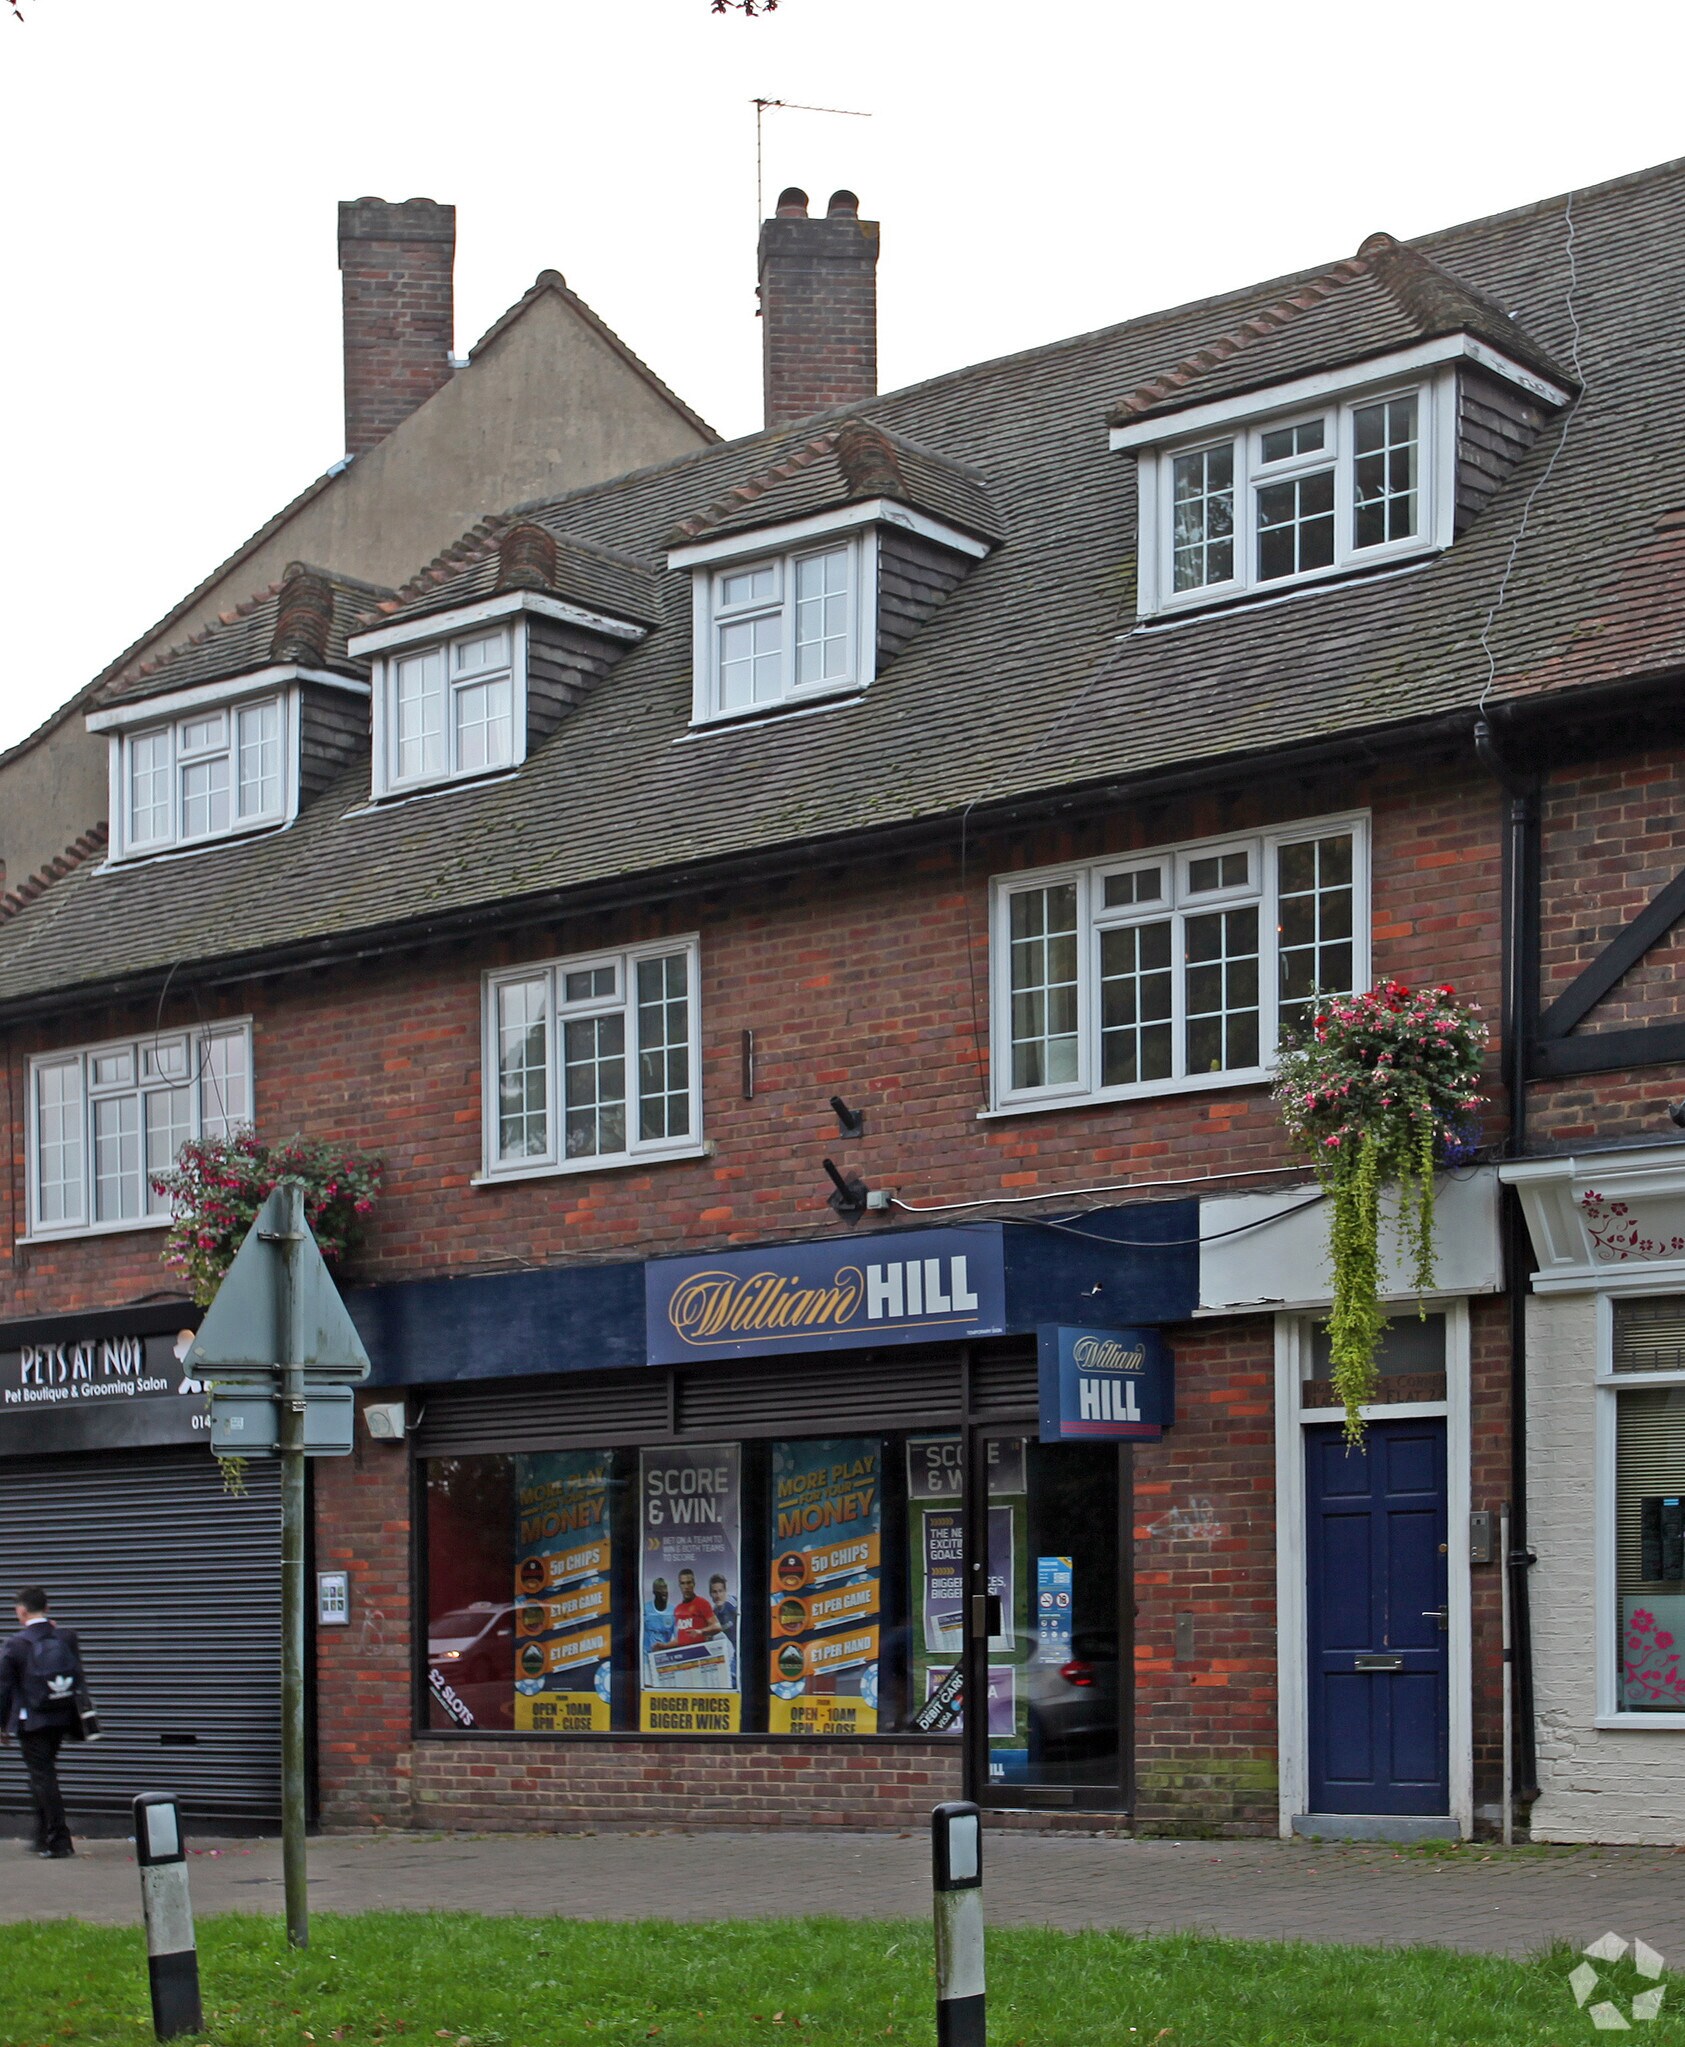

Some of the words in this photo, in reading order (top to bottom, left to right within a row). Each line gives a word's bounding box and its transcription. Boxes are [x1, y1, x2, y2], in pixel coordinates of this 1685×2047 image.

[669, 1266, 864, 1338] William
[866, 1255, 978, 1320] HILL
[21, 1342, 67, 1385] PETS
[72, 1340, 96, 1381] AT
[1073, 1336, 1146, 1370] William
[5, 1388, 22, 1403] Pet
[23, 1386, 69, 1403] Boutique
[71, 1387, 79, 1398] &
[81, 1379, 135, 1397] Grooming
[137, 1376, 167, 1392] Salon
[1080, 1378, 1141, 1421] HILL
[926, 1442, 999, 1467] SCE
[648, 1467, 729, 1496] SCORE
[778, 1468, 827, 1497] MORE
[832, 1455, 875, 1482] PLAY
[521, 1496, 606, 1544] MONEY
[648, 1499, 664, 1525] &
[669, 1497, 723, 1524] WIN.
[777, 1488, 875, 1539] MONEY
[930, 1528, 949, 1538] THE
[951, 1528, 963, 1538] NE
[930, 1538, 963, 1549] EXCITI
[550, 1560, 565, 1575] 5p
[566, 1548, 600, 1571] CHIPS
[811, 1556, 828, 1573] 5p
[831, 1543, 869, 1568] CHIPS
[930, 1549, 963, 1560] GOALS
[562, 1599, 578, 1614] PER
[579, 1592, 603, 1609] GAME
[811, 1602, 824, 1616] £1
[824, 1597, 842, 1613] PER
[843, 1590, 871, 1608] GAME
[562, 1642, 578, 1657] PER
[811, 1649, 824, 1662] £1
[824, 1643, 842, 1659] PER
[843, 1636, 871, 1654] HAND
[428, 1669, 445, 1690] £2
[442, 1686, 474, 1726] SLOTS
[532, 1702, 557, 1716] OPEN
[566, 1702, 592, 1716] 10AM
[650, 1696, 689, 1711] BIGGER
[691, 1696, 730, 1712] PRICES
[919, 1700, 945, 1731] DEBIT
[940, 1674, 964, 1703] CARD
[563, 1717, 592, 1731] CLOSE
[650, 1713, 692, 1729] BIGGER
[694, 1713, 730, 1730] WINS
[791, 1706, 818, 1721] OPEN
[827, 1707, 856, 1722] 10AM
[936, 1712, 952, 1729] VISA
